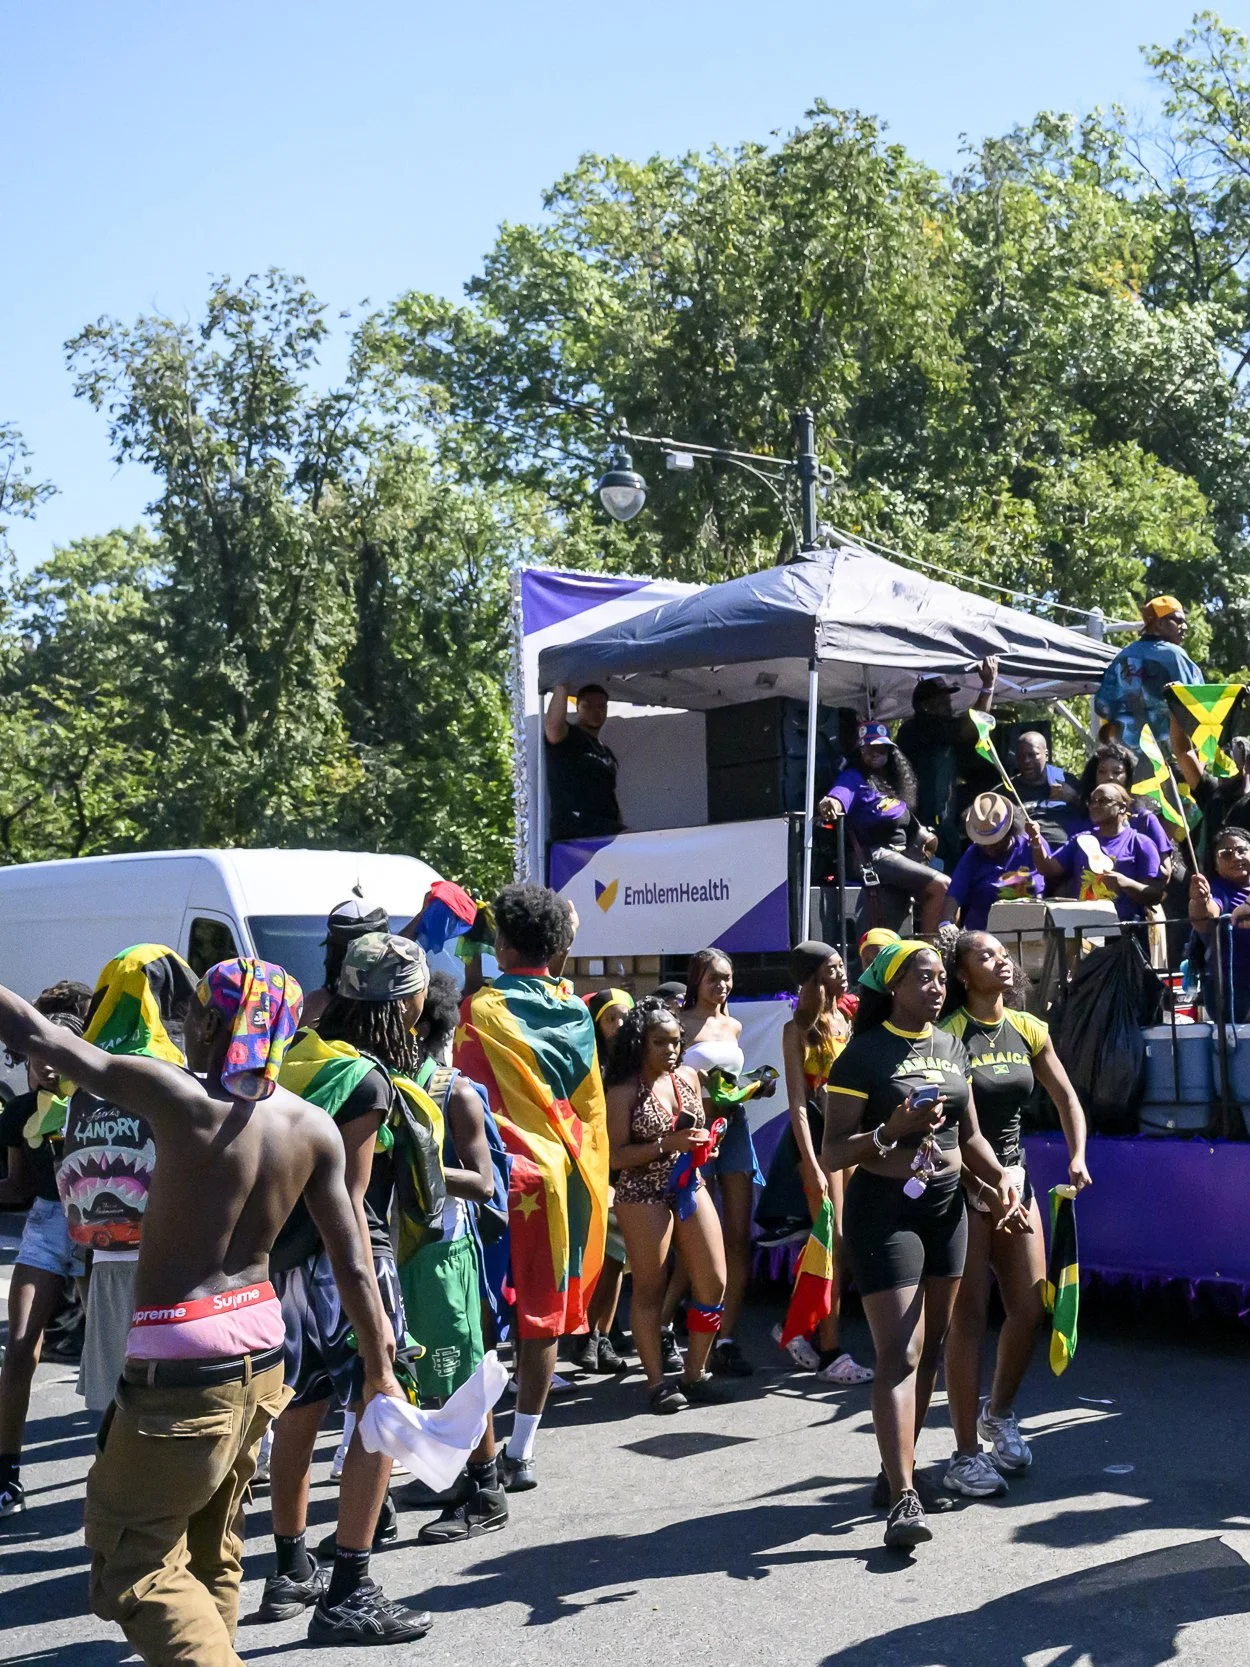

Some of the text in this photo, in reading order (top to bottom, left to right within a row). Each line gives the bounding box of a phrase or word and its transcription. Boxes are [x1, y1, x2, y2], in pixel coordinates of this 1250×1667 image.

[624, 878, 730, 906] EmblemHealth
[896, 1056, 962, 1076] JAMAICA
[970, 1051, 1031, 1069] AMAICA
[74, 1117, 140, 1147] LANDRY
